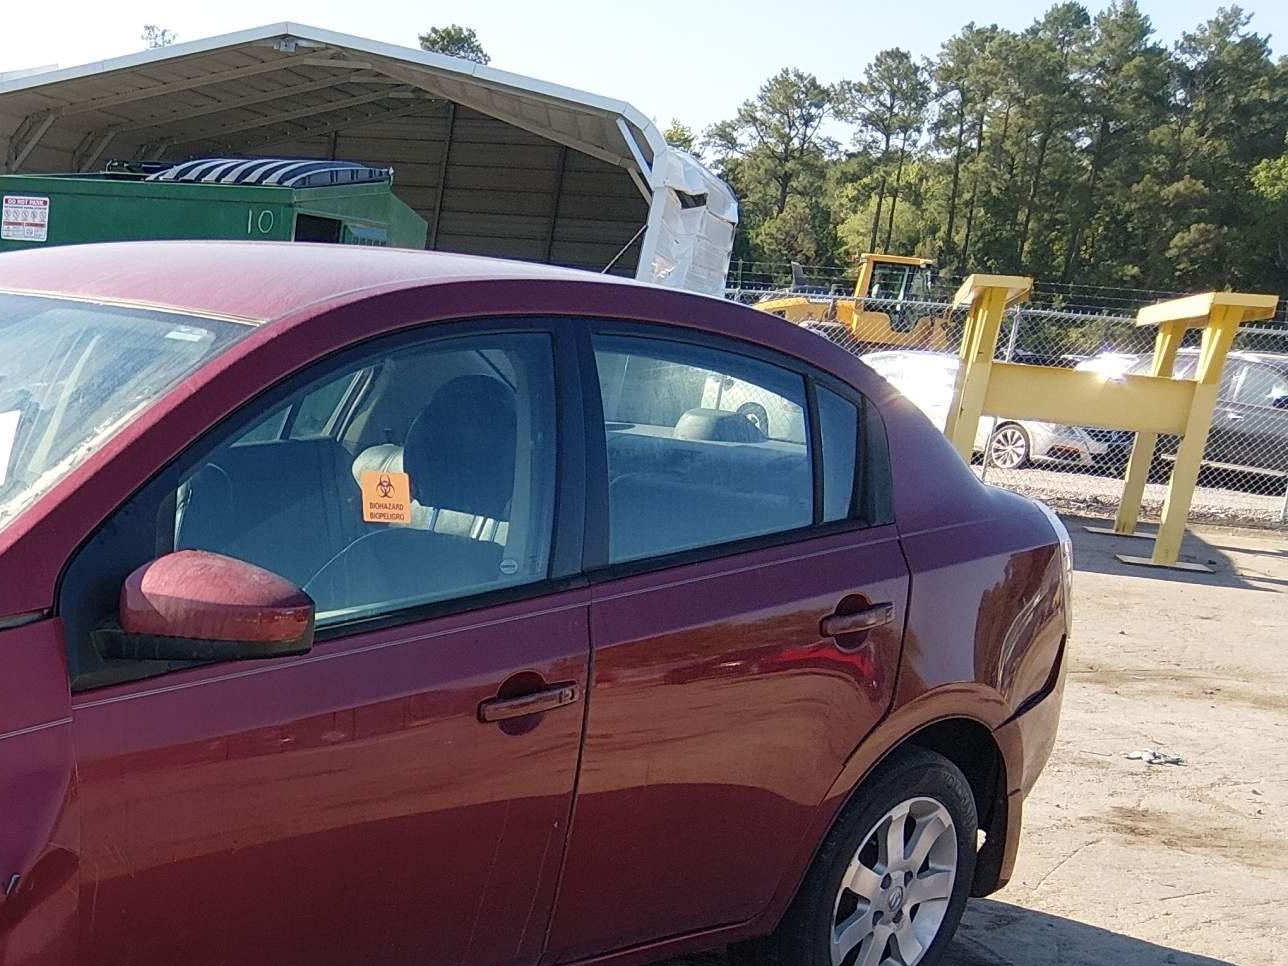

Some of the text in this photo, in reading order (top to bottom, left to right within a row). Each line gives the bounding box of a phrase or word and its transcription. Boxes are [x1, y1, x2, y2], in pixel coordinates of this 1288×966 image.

[247, 208, 274, 234] 10
[369, 502, 404, 511] BIOHAZARD
[369, 512, 405, 521] BIOPELIGRO
